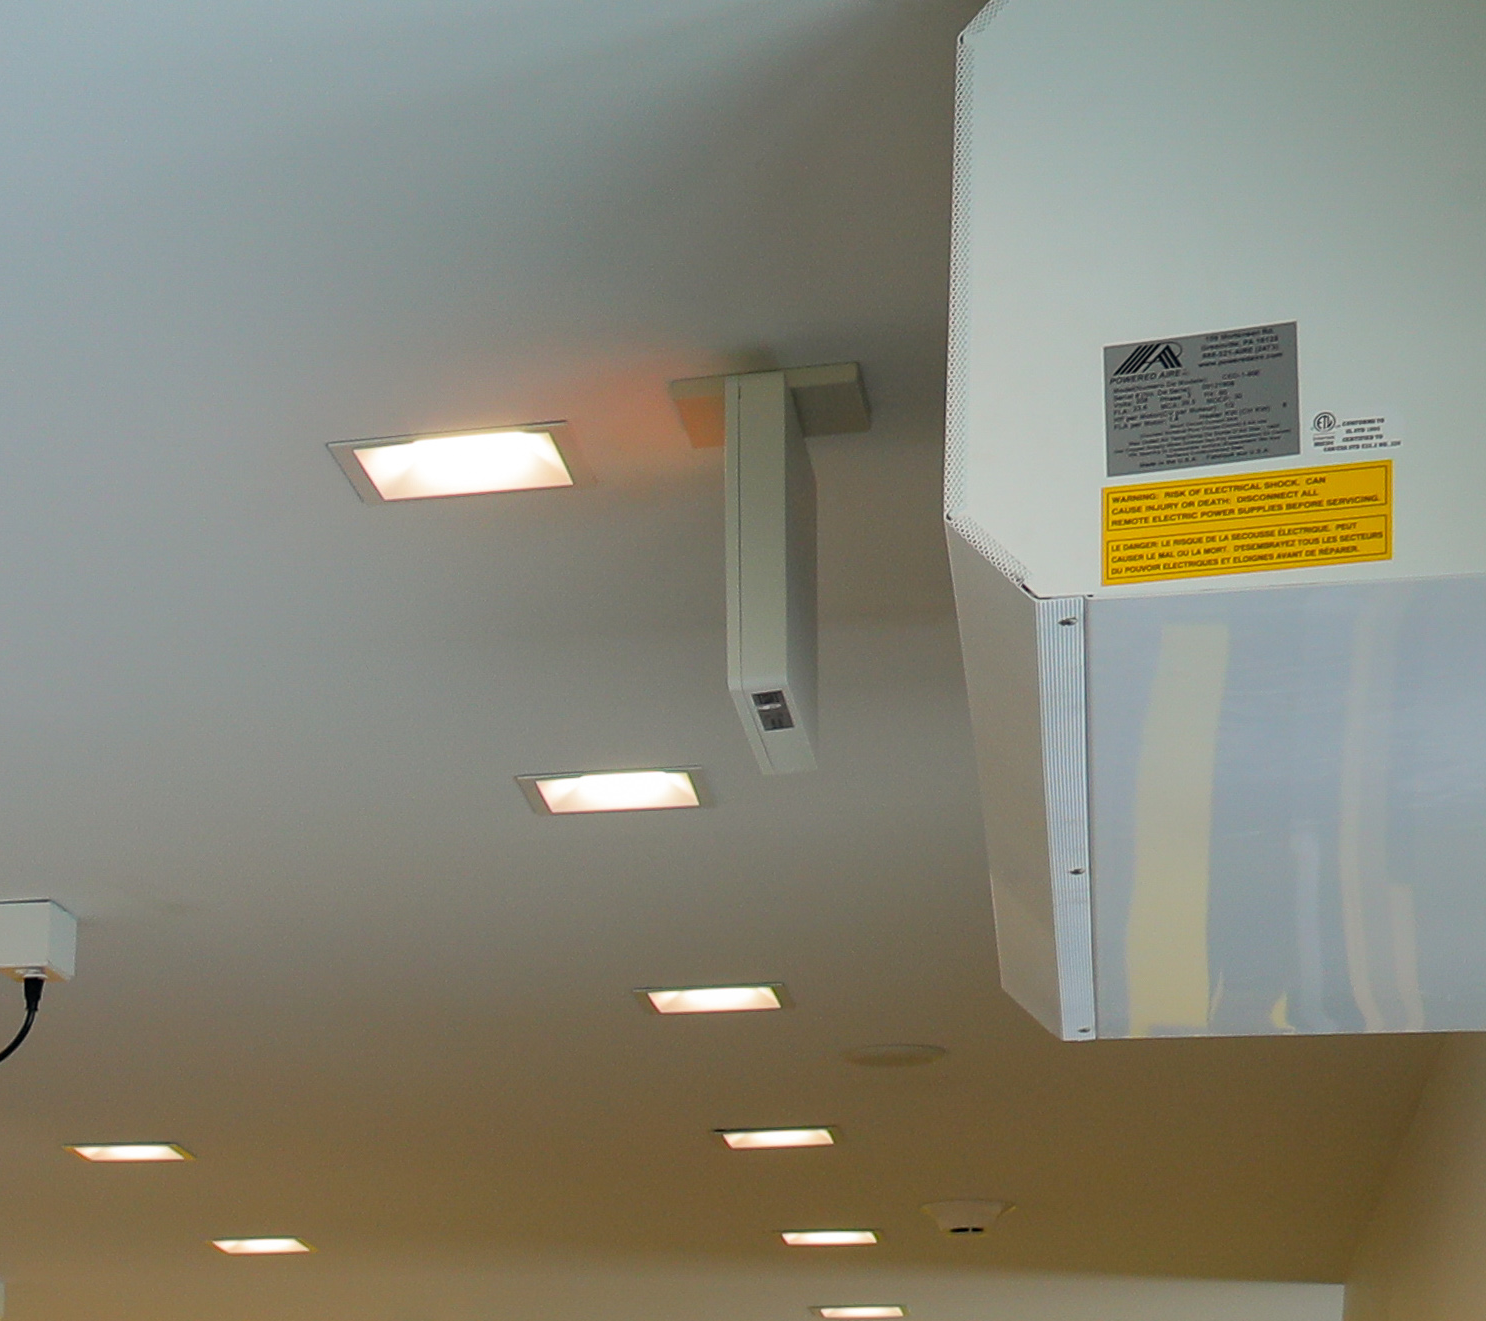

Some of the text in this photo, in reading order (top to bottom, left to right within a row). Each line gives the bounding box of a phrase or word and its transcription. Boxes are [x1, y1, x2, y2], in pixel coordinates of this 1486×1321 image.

[1109, 368, 1181, 385] POWERED AIRE
[1111, 476, 1326, 503] WARNING: RISK OF ELECTRICAL SHOCK. CAN
[1111, 489, 1319, 515] CAUSE INJURY OR DEATH: DISCONNECT ALL
[1111, 493, 1380, 526] REMOTE ELECTRIC POWER SUPPLIES BEFORE SERVICING.
